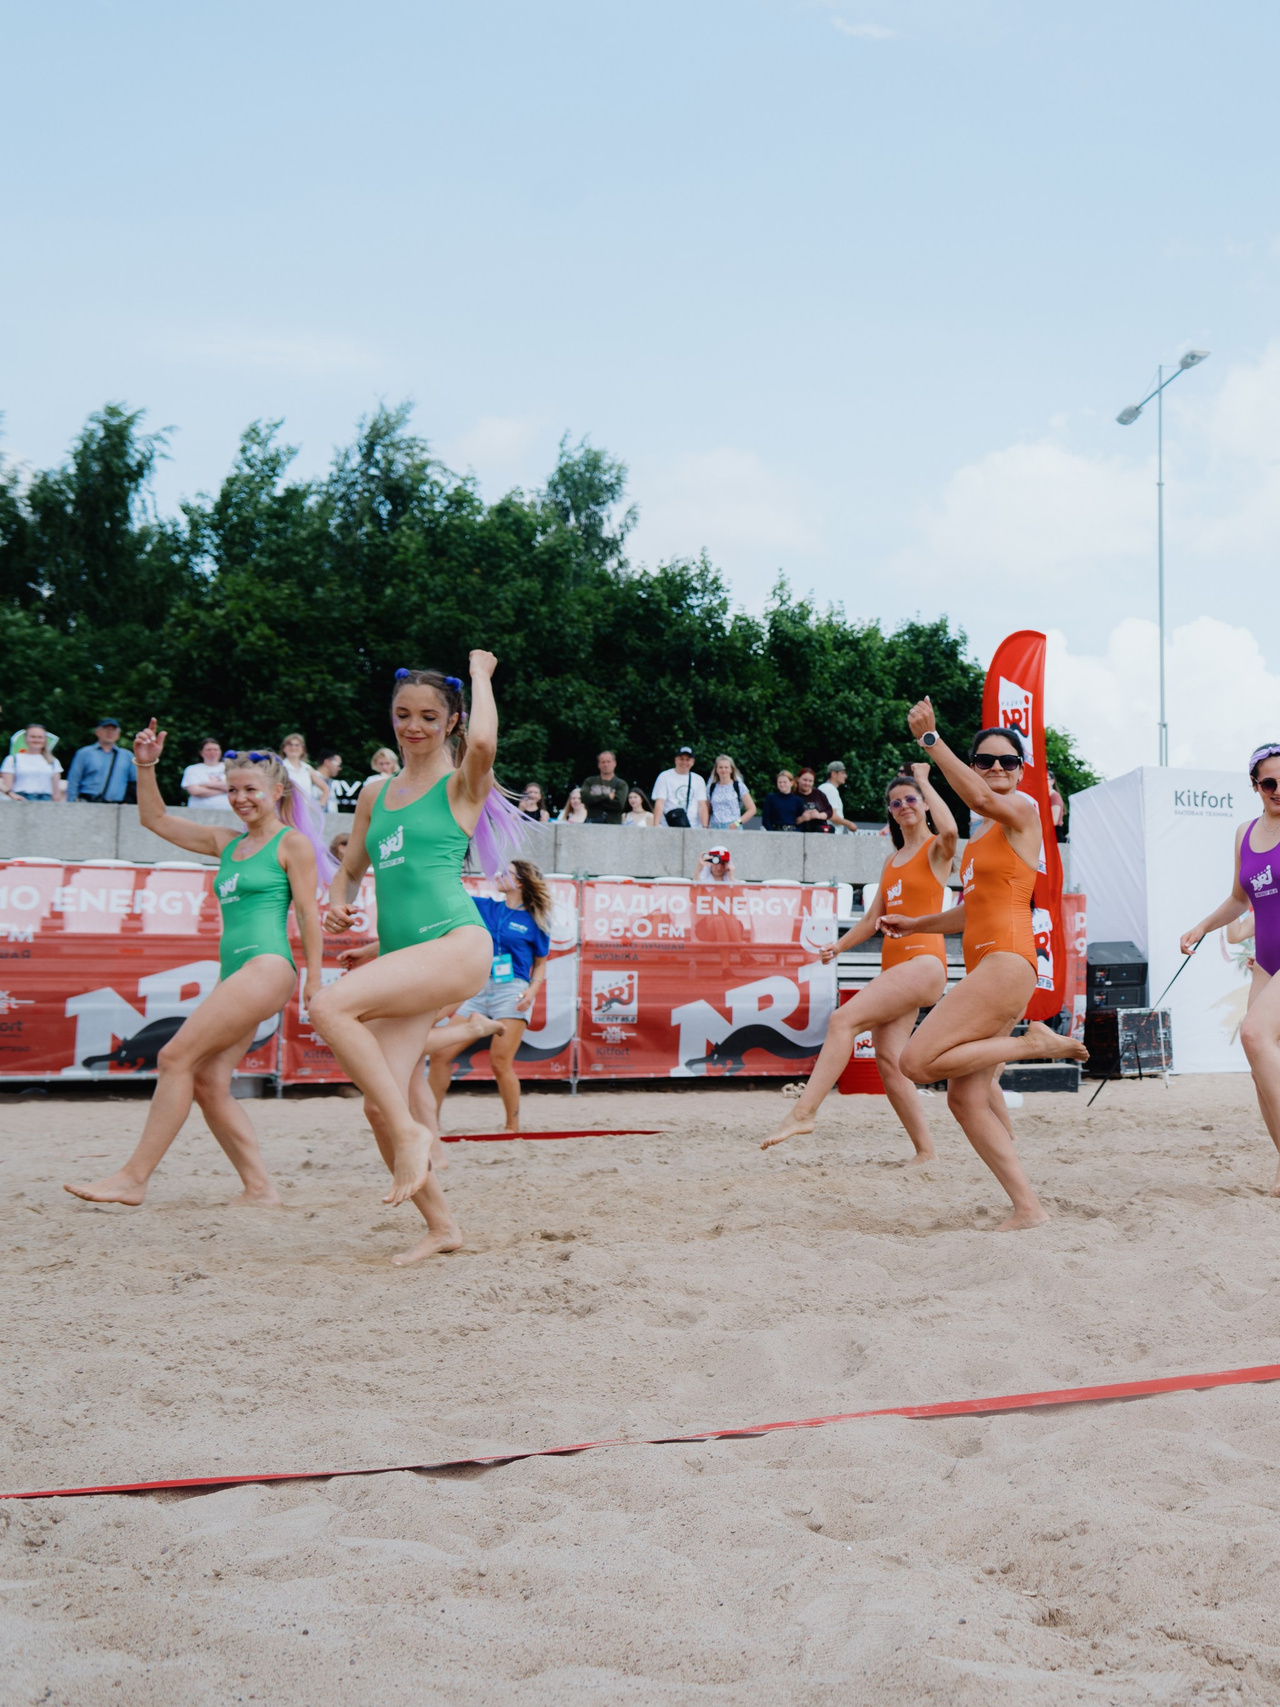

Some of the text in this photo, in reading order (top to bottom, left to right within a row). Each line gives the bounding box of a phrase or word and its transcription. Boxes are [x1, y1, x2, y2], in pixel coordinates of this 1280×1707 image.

[1174, 789, 1234, 809] Kitfort
[53, 887, 208, 915] ENERGY
[594, 893, 799, 917] РАДИО ENERGY
[593, 917, 686, 938] 95.0 FM
[595, 1047, 630, 1056] Kitfort
